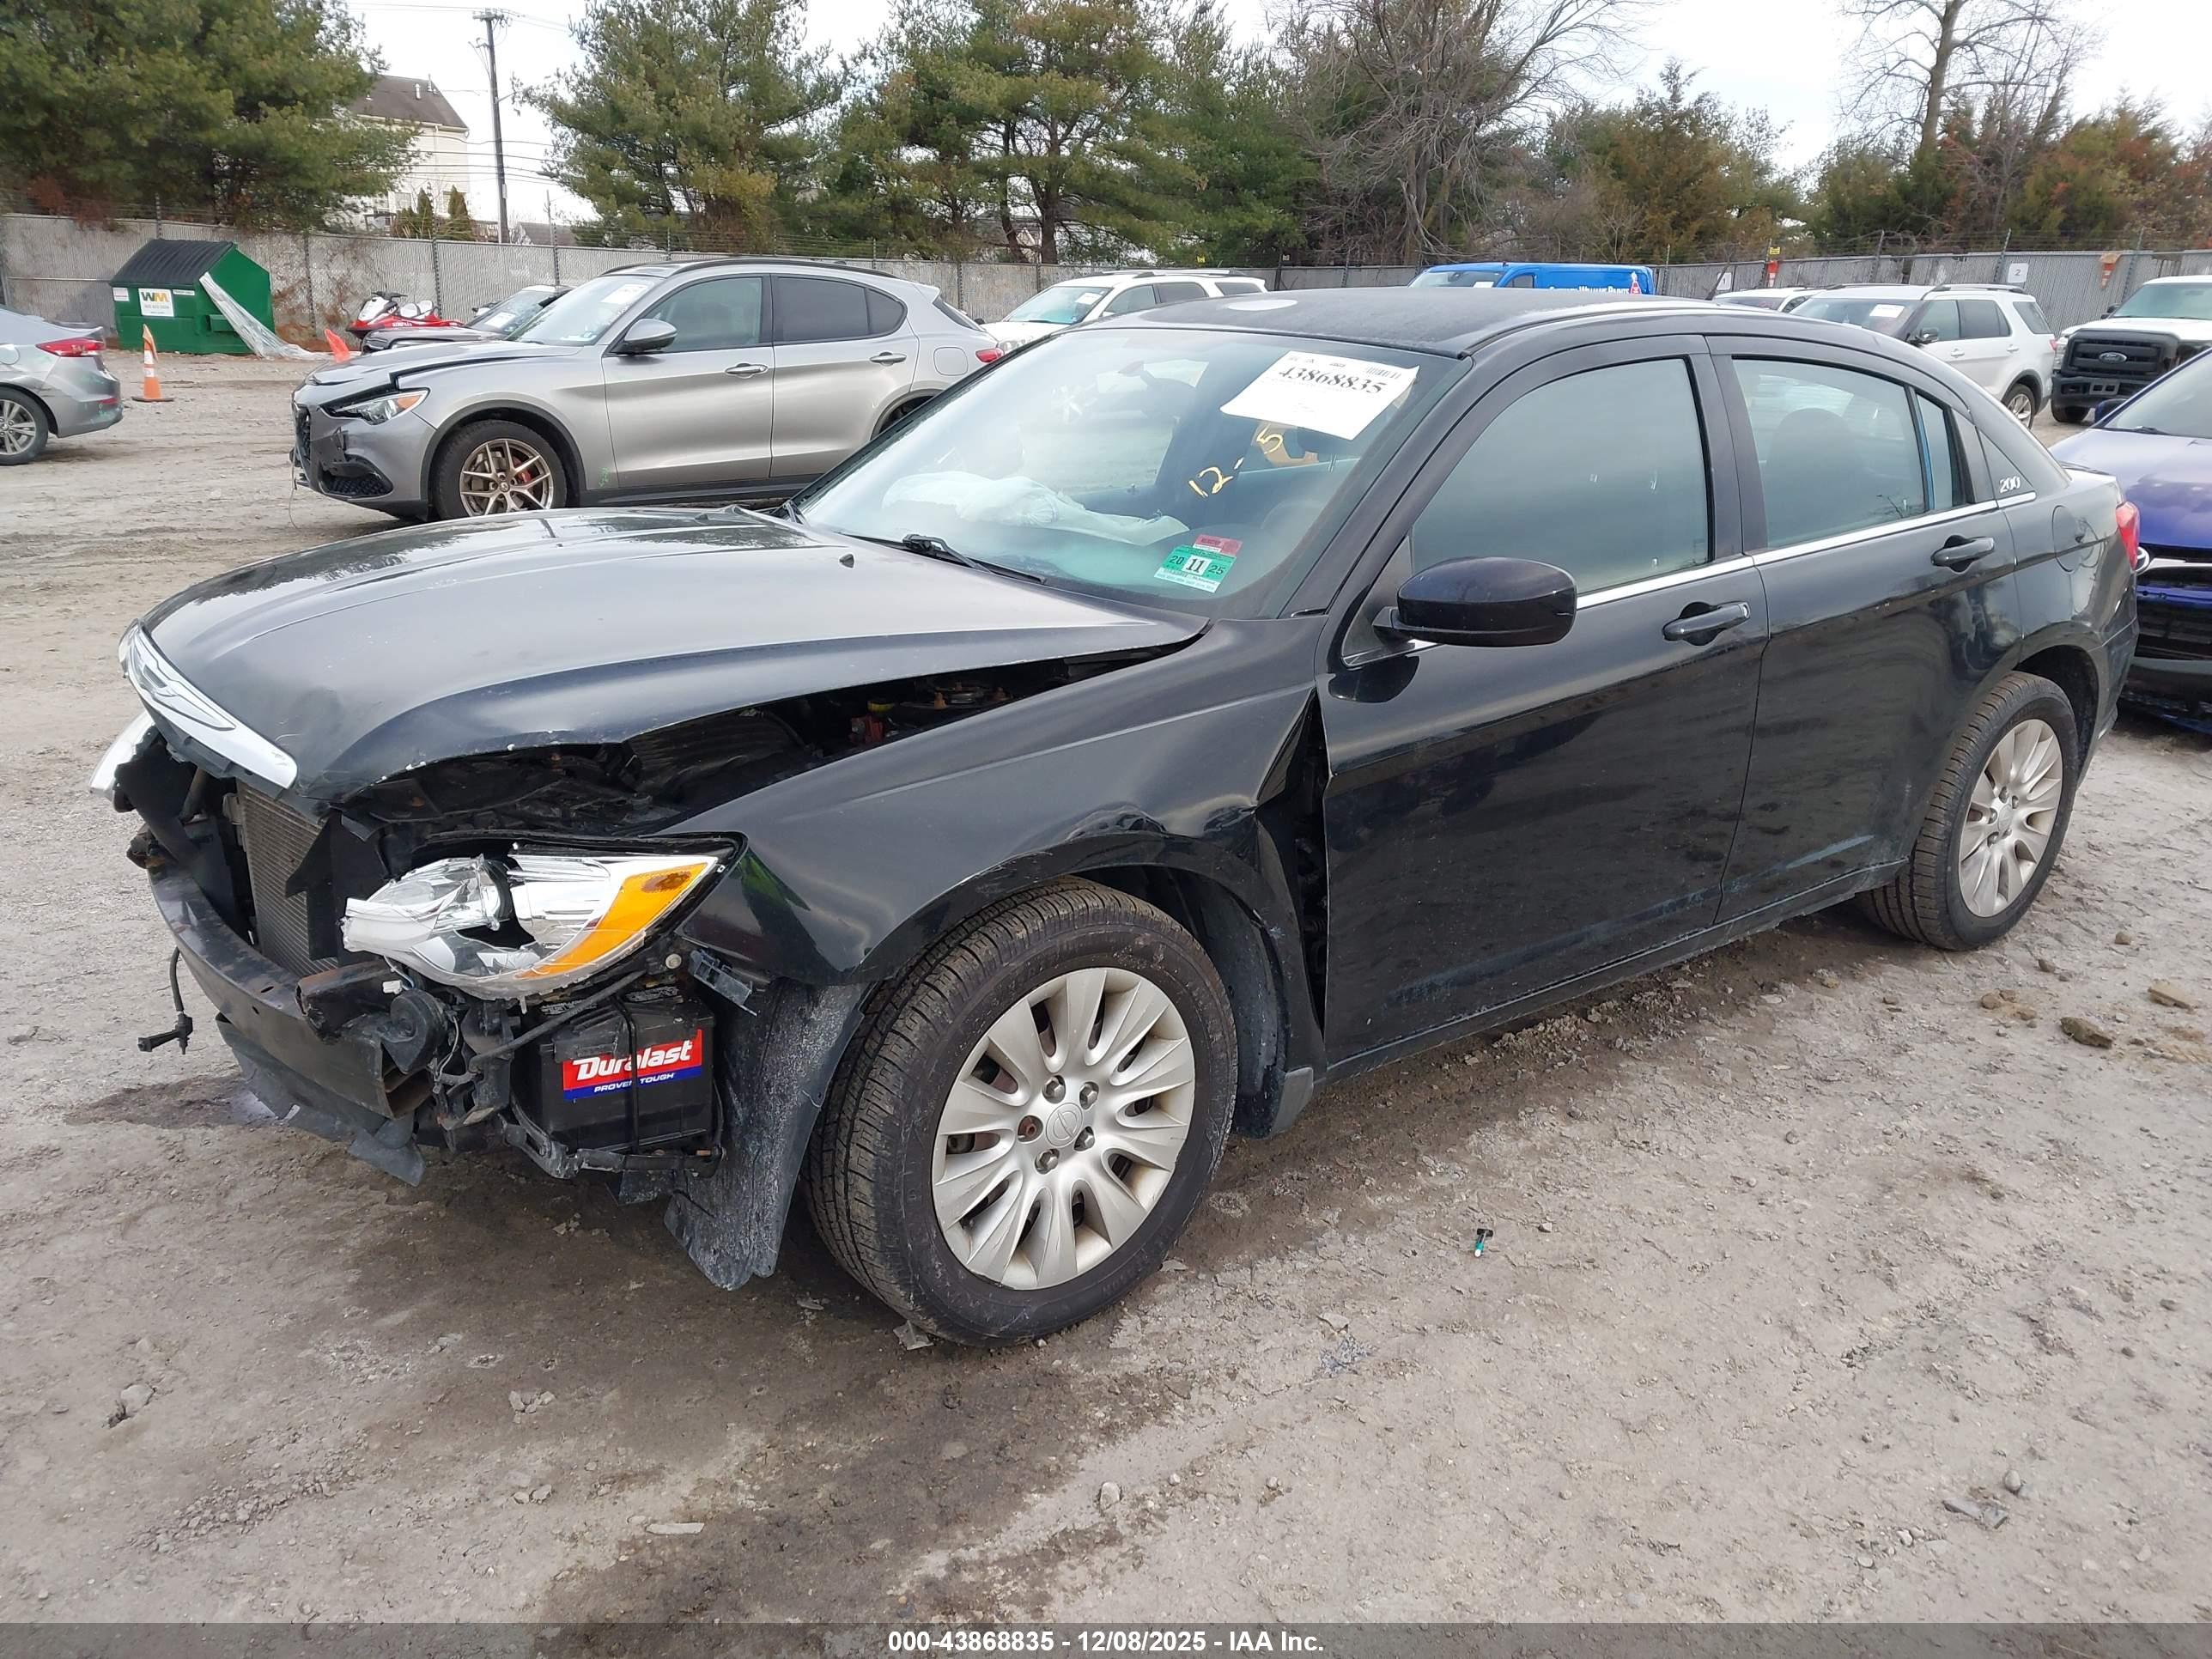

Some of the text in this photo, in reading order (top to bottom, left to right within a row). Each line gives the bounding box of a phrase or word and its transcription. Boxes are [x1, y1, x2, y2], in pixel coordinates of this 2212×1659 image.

[141, 291, 170, 302] WM
[1279, 366, 1388, 394] 43868835
[1999, 476, 2021, 494] 200
[1169, 555, 1185, 565] 20
[1186, 558, 1206, 573] 11
[1208, 564, 1226, 575] 25
[573, 1039, 693, 1081] Duralast
[640, 1073, 676, 1085] TOUGH
